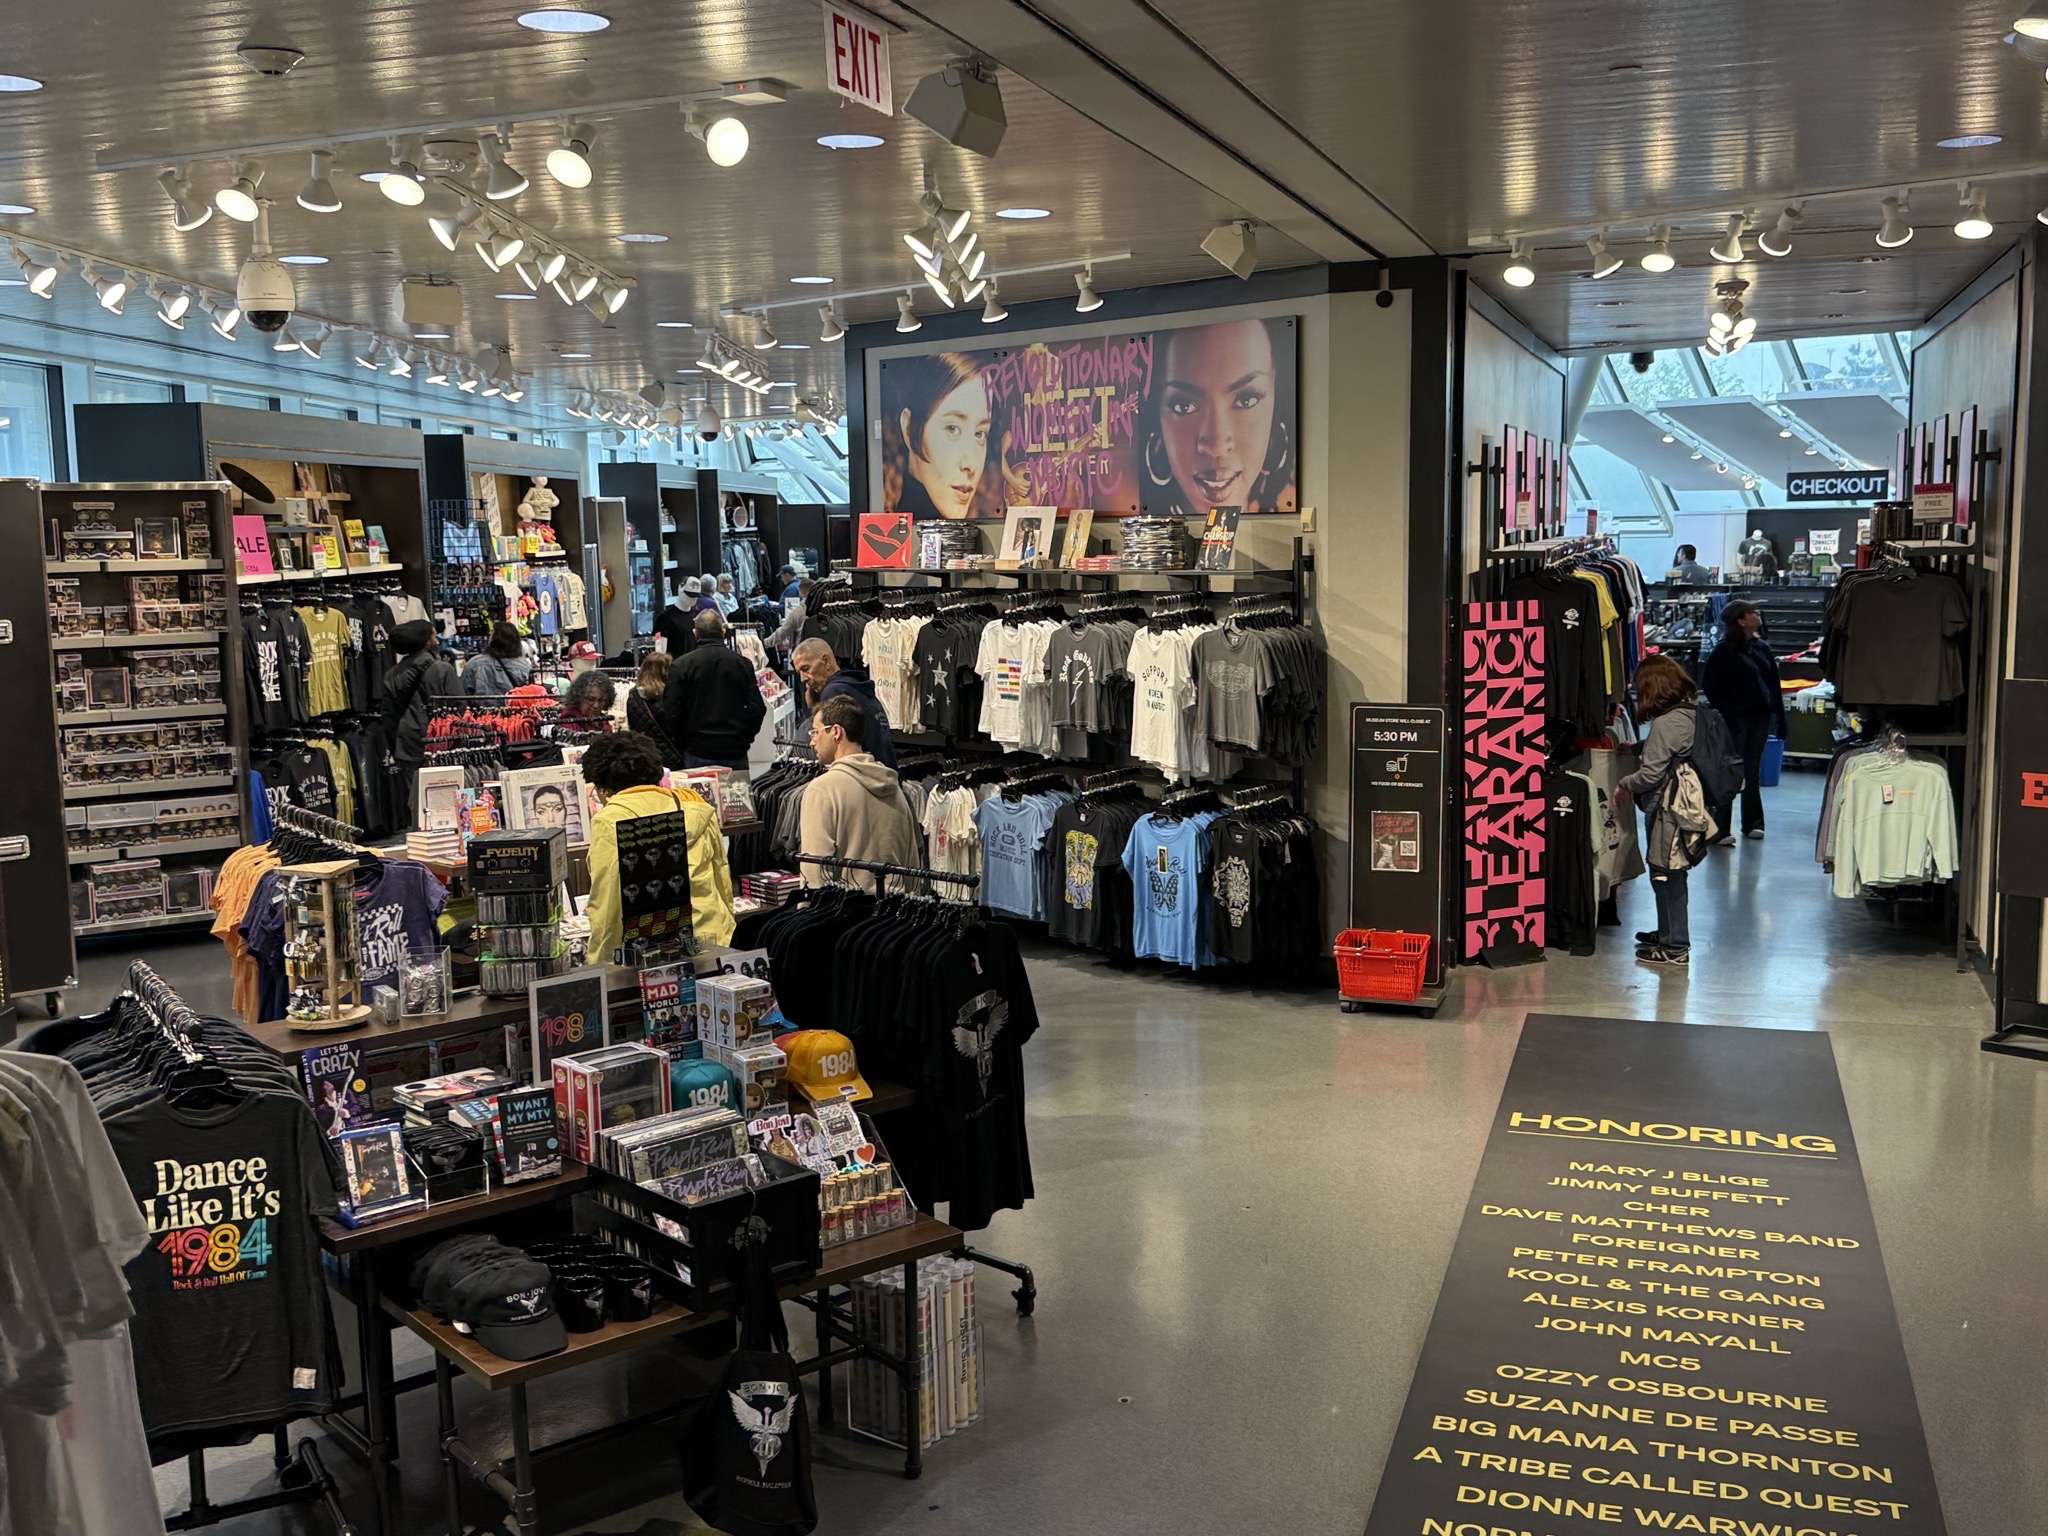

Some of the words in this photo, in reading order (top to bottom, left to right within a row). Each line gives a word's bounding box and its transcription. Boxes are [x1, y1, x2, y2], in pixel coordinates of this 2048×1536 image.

[832, 12, 880, 104] EXIT
[981, 334, 1154, 418] REVOLUTIONARY
[1011, 393, 1097, 452] WOMEN
[1108, 398, 1134, 440] IN
[1790, 477, 1886, 495] CHECKOUT
[236, 536, 267, 553] ALE
[1142, 665, 1169, 686] SUPPORT
[1373, 731, 1398, 742] 5:30
[1399, 731, 1418, 742] PM
[1486, 599, 1525, 948] CLEARANCE
[990, 825, 1001, 847] ROCK
[1003, 822, 1016, 833] AND
[647, 984, 679, 1000] MAD
[648, 998, 680, 1010] WORLD
[540, 1009, 600, 1047] 1984
[311, 1050, 360, 1076] CRAZY
[320, 1045, 338, 1056] LET'S
[339, 1044, 348, 1052] GO
[818, 1050, 855, 1078] 1984
[513, 1097, 548, 1111] WANT
[688, 1080, 728, 1106] 1984
[507, 1113, 524, 1124] MY
[526, 1108, 551, 1121] MTV
[756, 1120, 773, 1131] Bon
[775, 1116, 790, 1129] Jovi
[1508, 1111, 1837, 1153] HONORING
[651, 1139, 701, 1180] Purple
[701, 1135, 733, 1163] Rain
[154, 1156, 268, 1196] Dance
[663, 1169, 717, 1199] Purple
[716, 1168, 748, 1189] Rain
[1568, 1160, 1655, 1177] MARY
[1661, 1169, 1674, 1179] J
[1681, 1171, 1769, 1188] BLIGE
[1547, 1176, 1643, 1193] JIMMY
[1650, 1185, 1790, 1206] BUFFETT
[143, 1192, 223, 1235] Like
[229, 1182, 280, 1221] It's
[1622, 1200, 1710, 1217] CHER
[1480, 1203, 1563, 1222] DAVE
[1569, 1213, 1757, 1240] MATTHEWS
[1763, 1231, 1860, 1249] BAND
[156, 1217, 272, 1278] 1984
[1571, 1232, 1761, 1261] FOREIGNER
[173, 1279, 192, 1290] Rock
[219, 1272, 235, 1285] Hall
[236, 1270, 246, 1282] Of
[1512, 1246, 1619, 1268] PETER
[1626, 1257, 1821, 1287] FRAMPTON
[506, 1292, 526, 1304] BON
[1506, 1266, 1599, 1288] KOOL
[1606, 1278, 1631, 1291] &
[1639, 1280, 1710, 1299] THE
[1717, 1288, 1825, 1310] GANG
[1522, 1291, 1647, 1314] ALEXIS
[1655, 1304, 1806, 1332] KORNER
[1534, 1316, 1632, 1338] JOHN
[1641, 1327, 1791, 1355] MAYALL
[1619, 1350, 1702, 1372] MC5
[743, 1383, 766, 1393] BON
[1495, 1364, 1598, 1388] OZZY
[1607, 1377, 1829, 1414] OSBOURNE
[1463, 1388, 1655, 1425] SUZANNE
[1665, 1411, 1718, 1432] DE
[1729, 1419, 1860, 1448] PASSE
[1431, 1414, 1497, 1437] BIG
[1507, 1424, 1639, 1455] MAMA
[1649, 1440, 1893, 1485] THORNTON
[1413, 1446, 1442, 1463] A
[1455, 1449, 1573, 1480] TRIBE
[1582, 1467, 1749, 1502] CALLED
[1759, 1488, 1909, 1519] QUEST
[1456, 1485, 1624, 1523] DIONNE
[1633, 1507, 1858, 1536] WARWI
